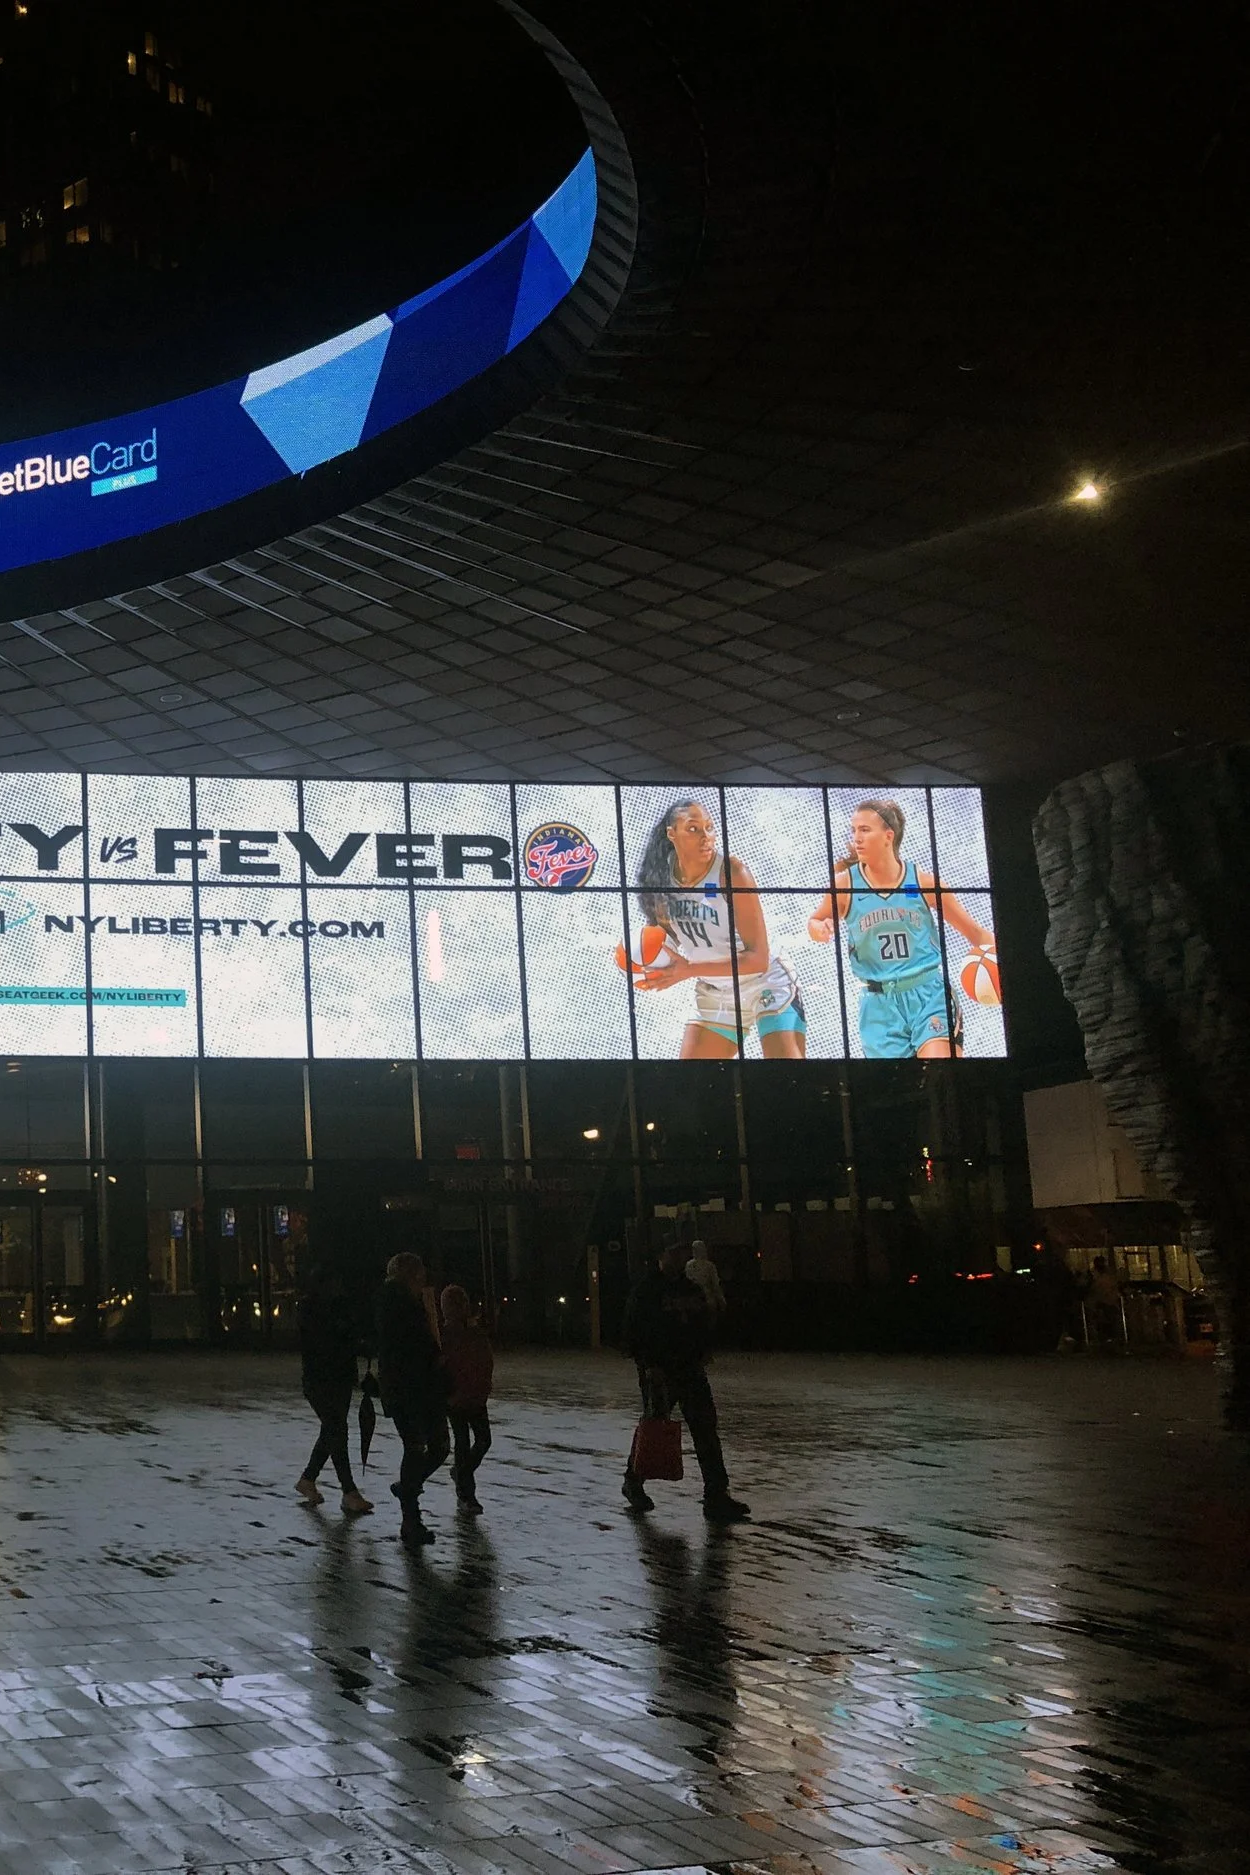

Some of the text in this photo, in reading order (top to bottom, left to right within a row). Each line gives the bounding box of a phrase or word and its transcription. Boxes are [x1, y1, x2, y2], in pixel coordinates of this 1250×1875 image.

[533, 828, 582, 846] INDIANA
[154, 827, 513, 880] FEVER
[527, 840, 597, 879] Fever
[44, 914, 385, 939] NYLIBERTY.COM
[676, 920, 713, 948] 44
[877, 932, 910, 961] 20
